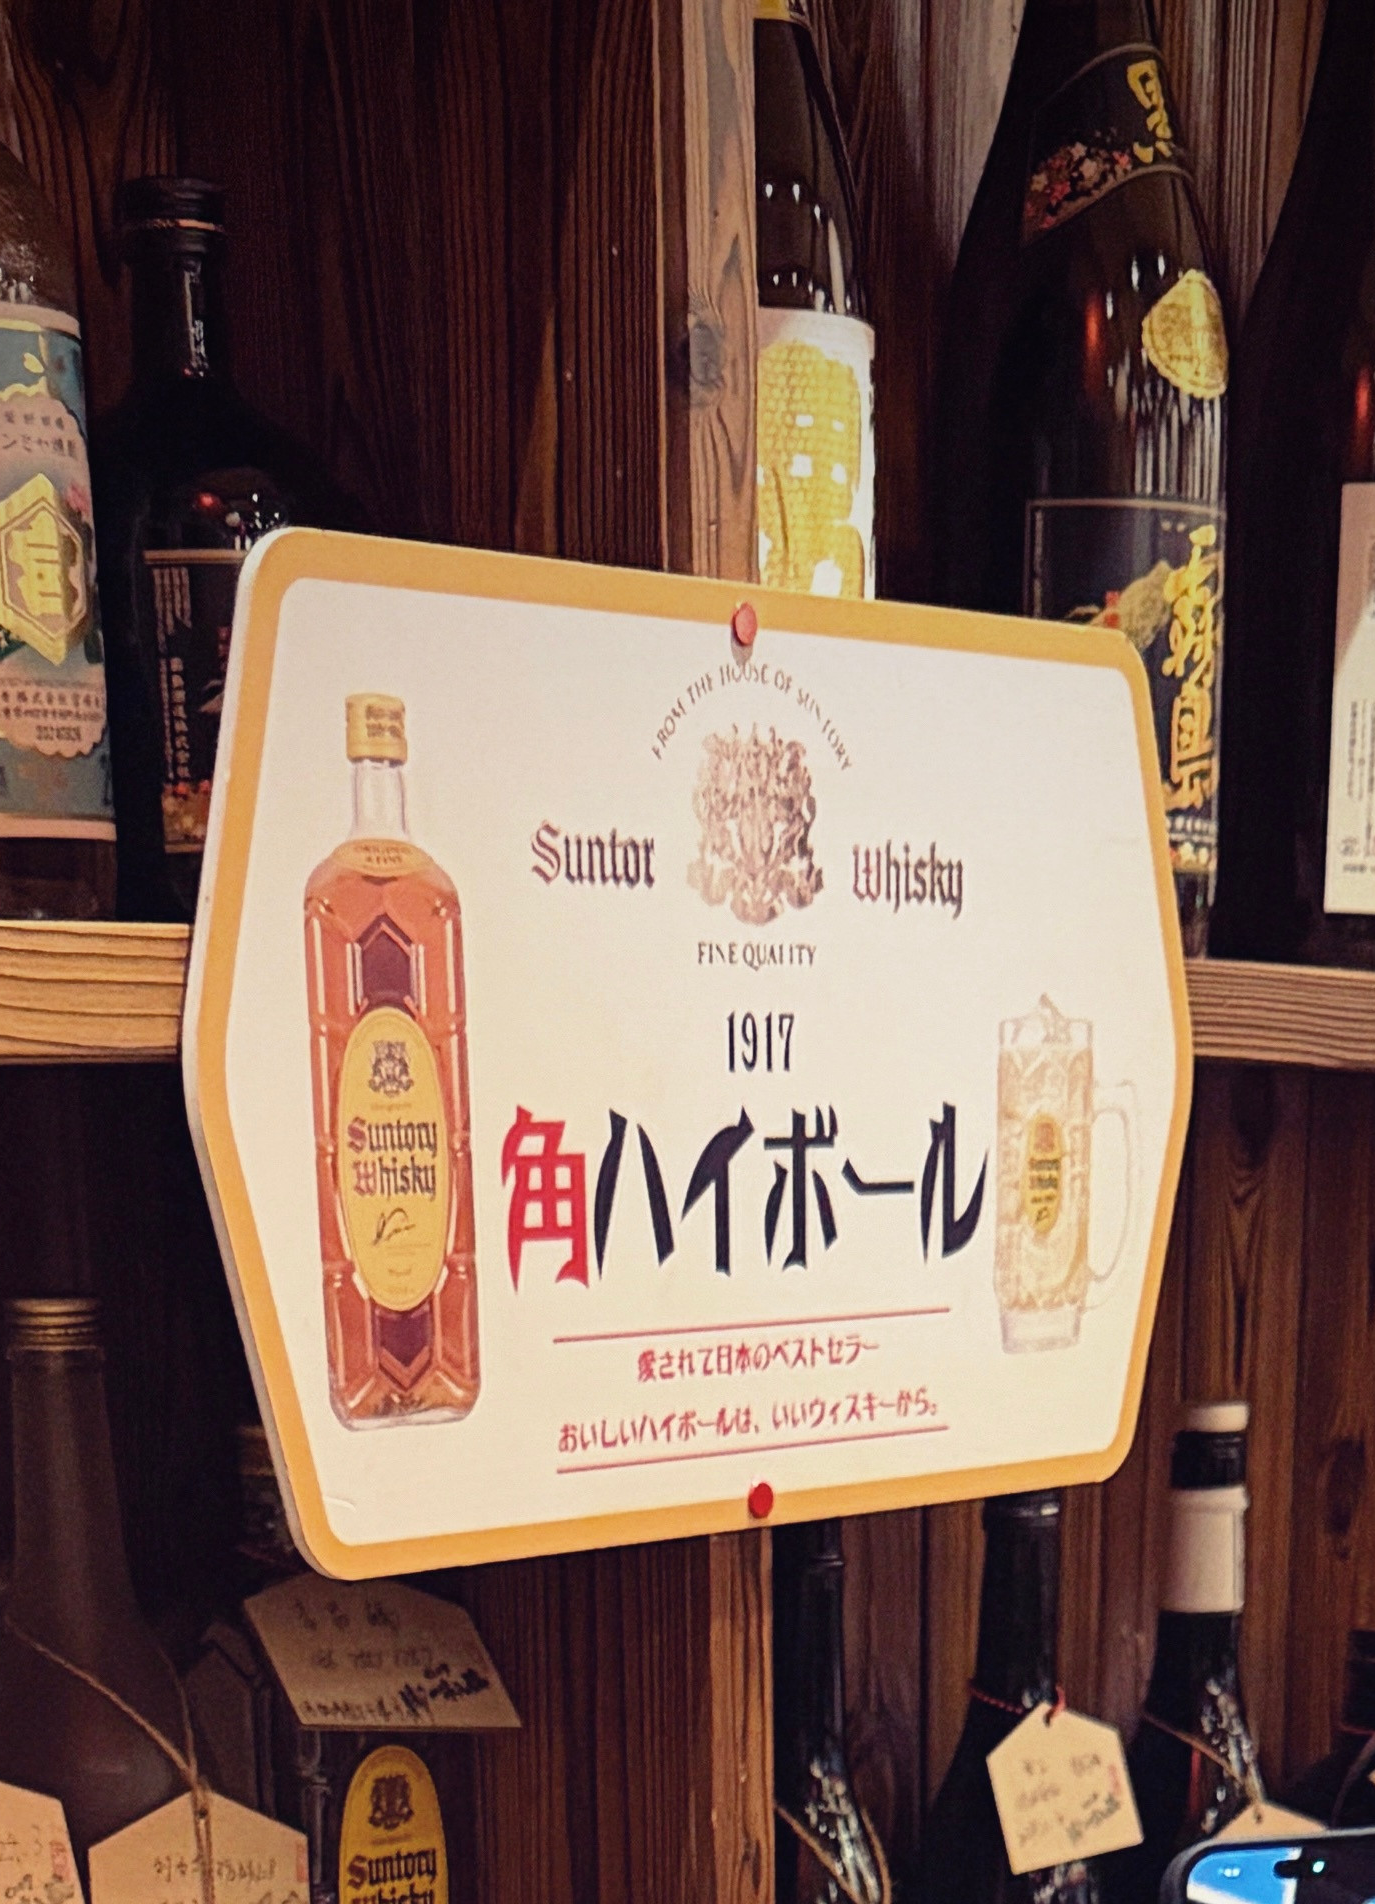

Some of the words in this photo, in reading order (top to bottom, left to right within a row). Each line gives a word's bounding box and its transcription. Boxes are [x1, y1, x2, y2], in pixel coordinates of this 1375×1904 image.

[687, 675, 715, 706] THE
[775, 669, 793, 694] OF
[531, 820, 656, 889] Suntor
[852, 839, 964, 920] Whisky
[698, 943, 739, 966] FINE
[726, 1011, 795, 1074] 1917
[347, 1116, 438, 1157] Suntory
[352, 1155, 437, 1201] Whisky
[501, 1100, 989, 1293] 角ハイボール
[347, 1844, 436, 1897] Suntory
